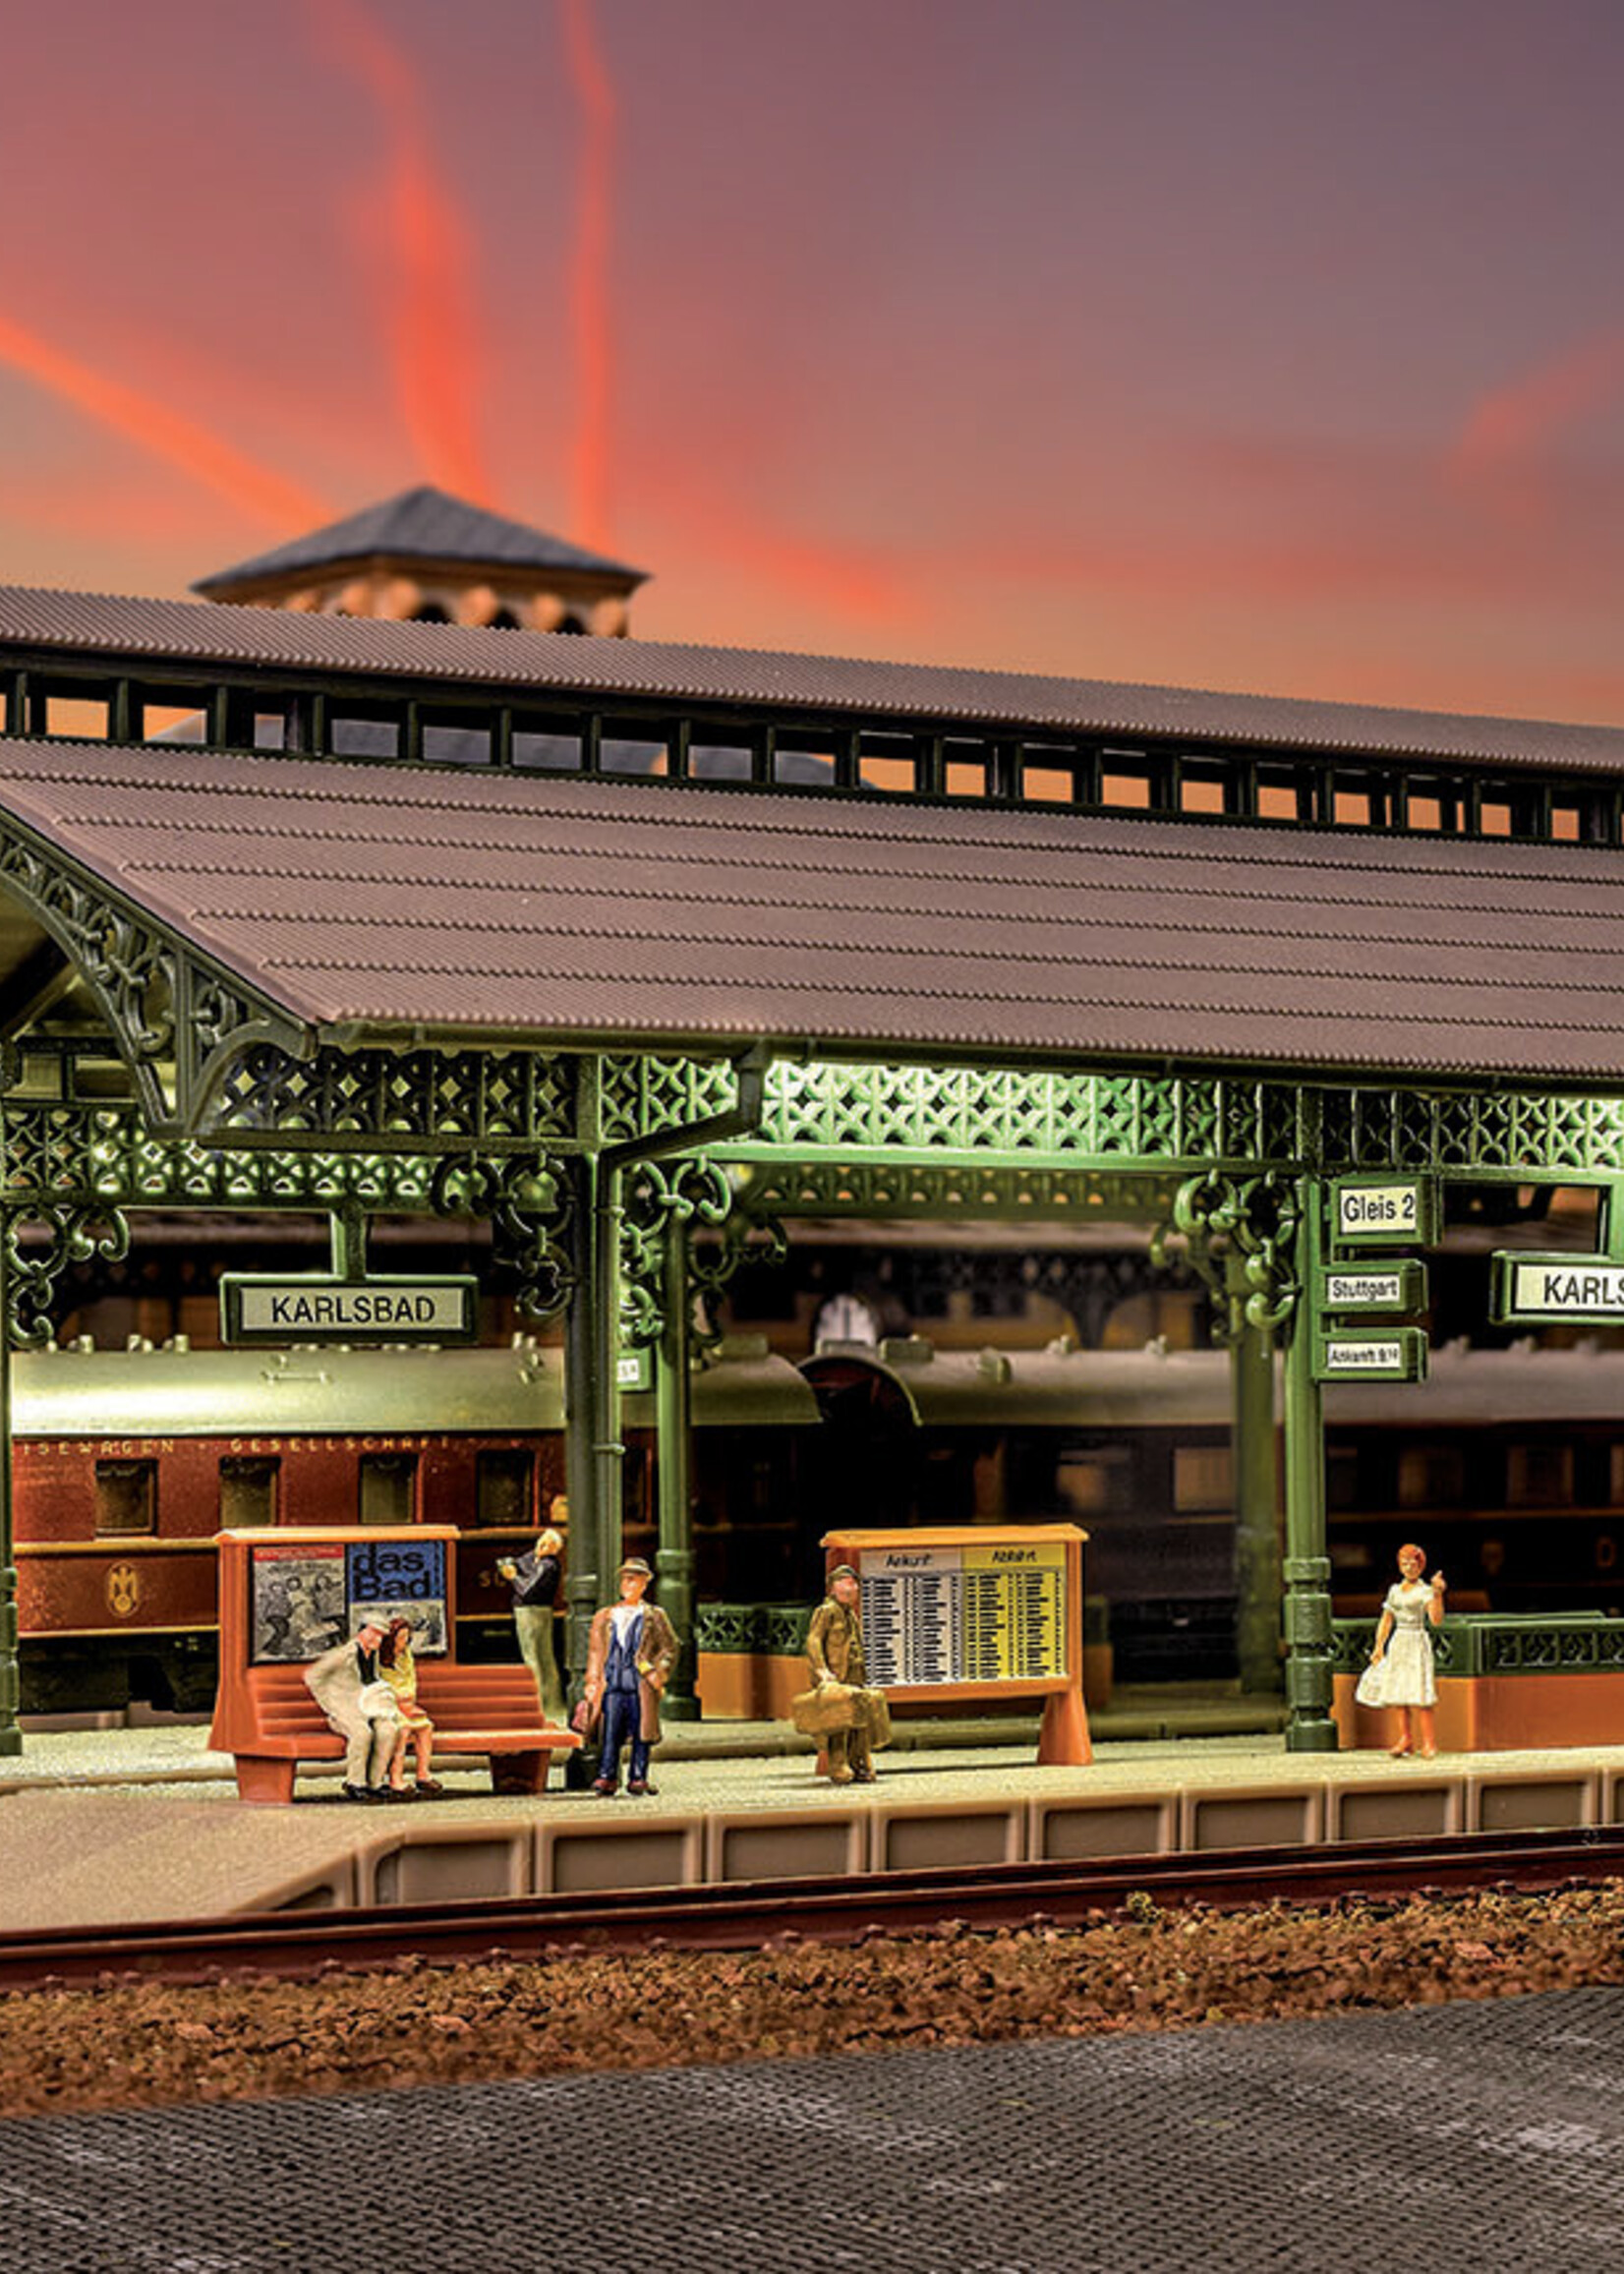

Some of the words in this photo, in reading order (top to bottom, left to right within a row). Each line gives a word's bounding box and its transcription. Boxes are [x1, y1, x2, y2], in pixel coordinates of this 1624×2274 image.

[1343, 1195, 1397, 1222] Gleis
[1401, 1193, 1416, 1220] 2
[1332, 1279, 1398, 1303] Stuttgart
[271, 1295, 436, 1323] KARLSBAD
[229, 1435, 449, 1453] GESELLSCHAFT
[353, 1542, 426, 1573] das
[354, 1571, 431, 1601] Bad
